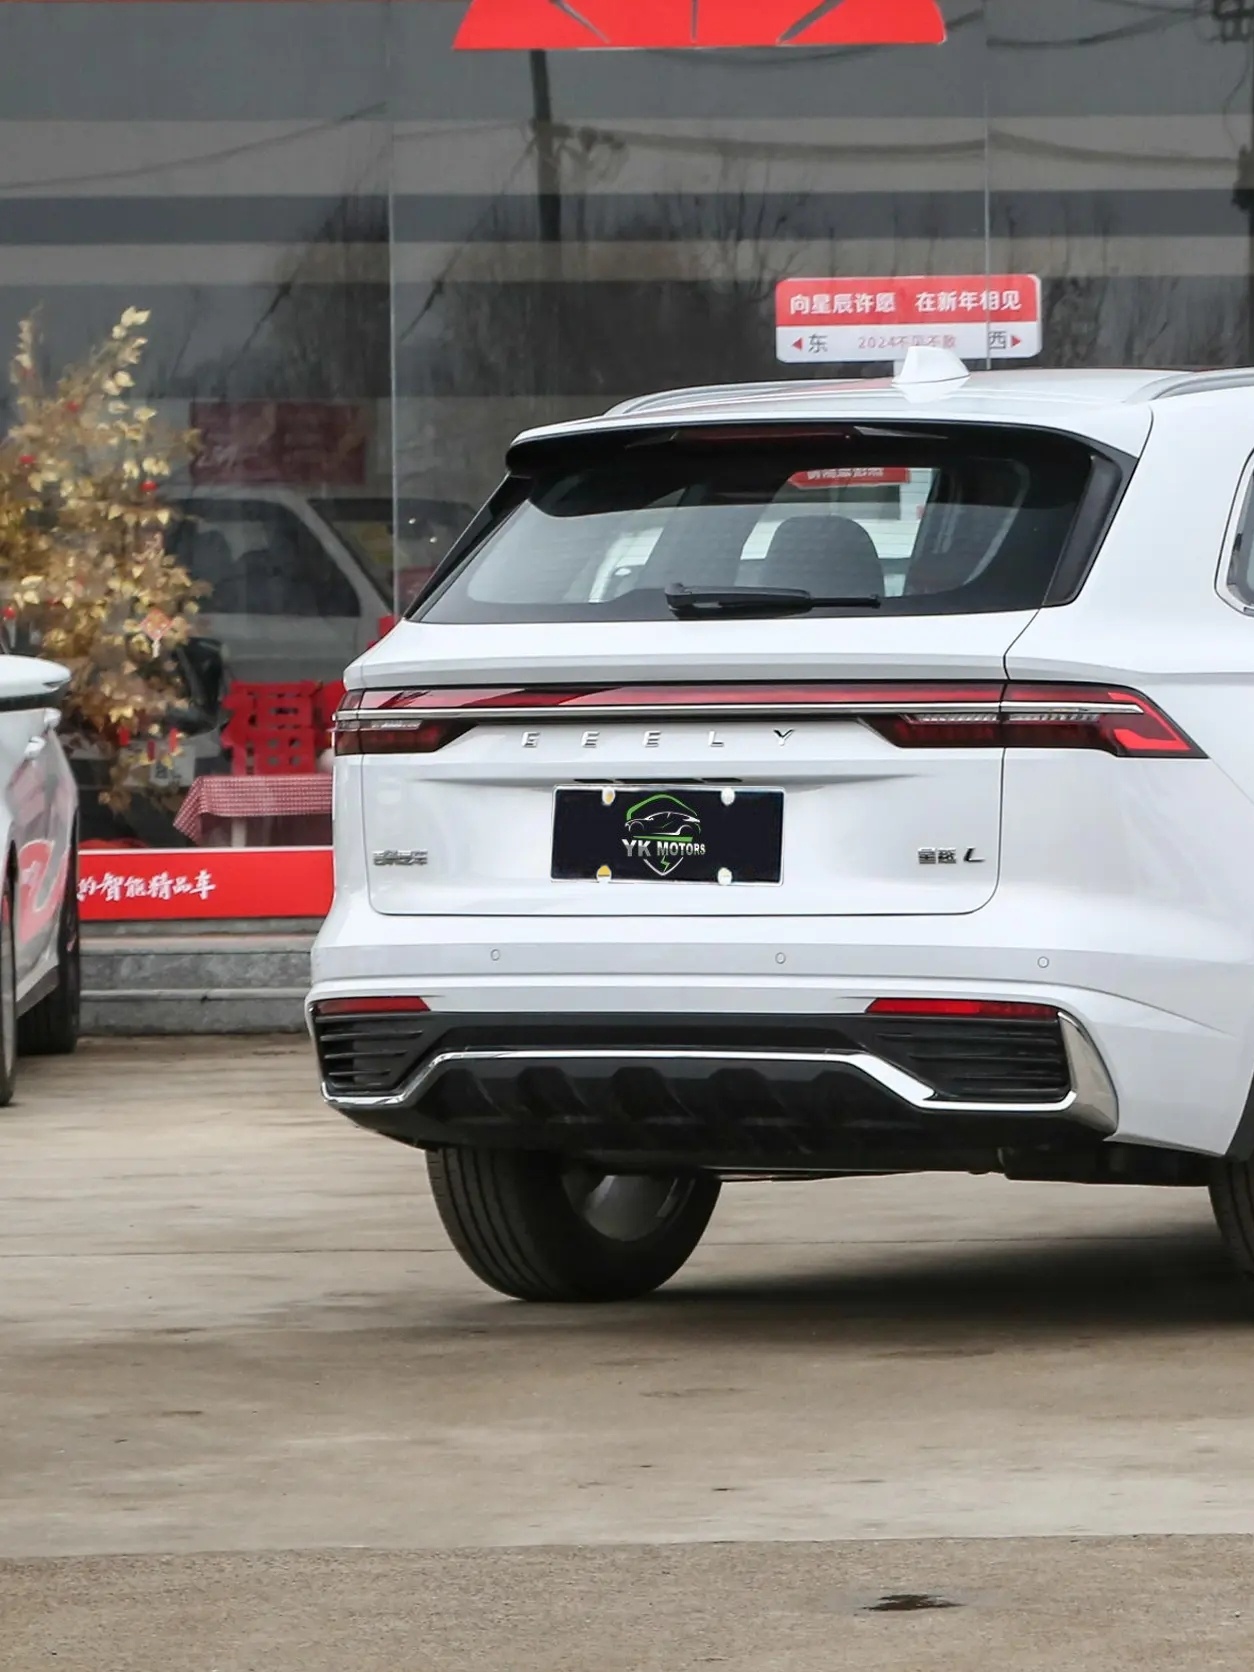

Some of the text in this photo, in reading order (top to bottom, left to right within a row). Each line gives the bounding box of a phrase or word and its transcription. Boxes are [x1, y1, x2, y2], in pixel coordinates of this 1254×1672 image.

[789, 289, 1022, 316] 向星辰许愿 在新年相见
[807, 333, 829, 354] 东
[987, 330, 1007, 350] 西
[963, 846, 987, 863] L
[77, 869, 217, 902] 的智能精品车
